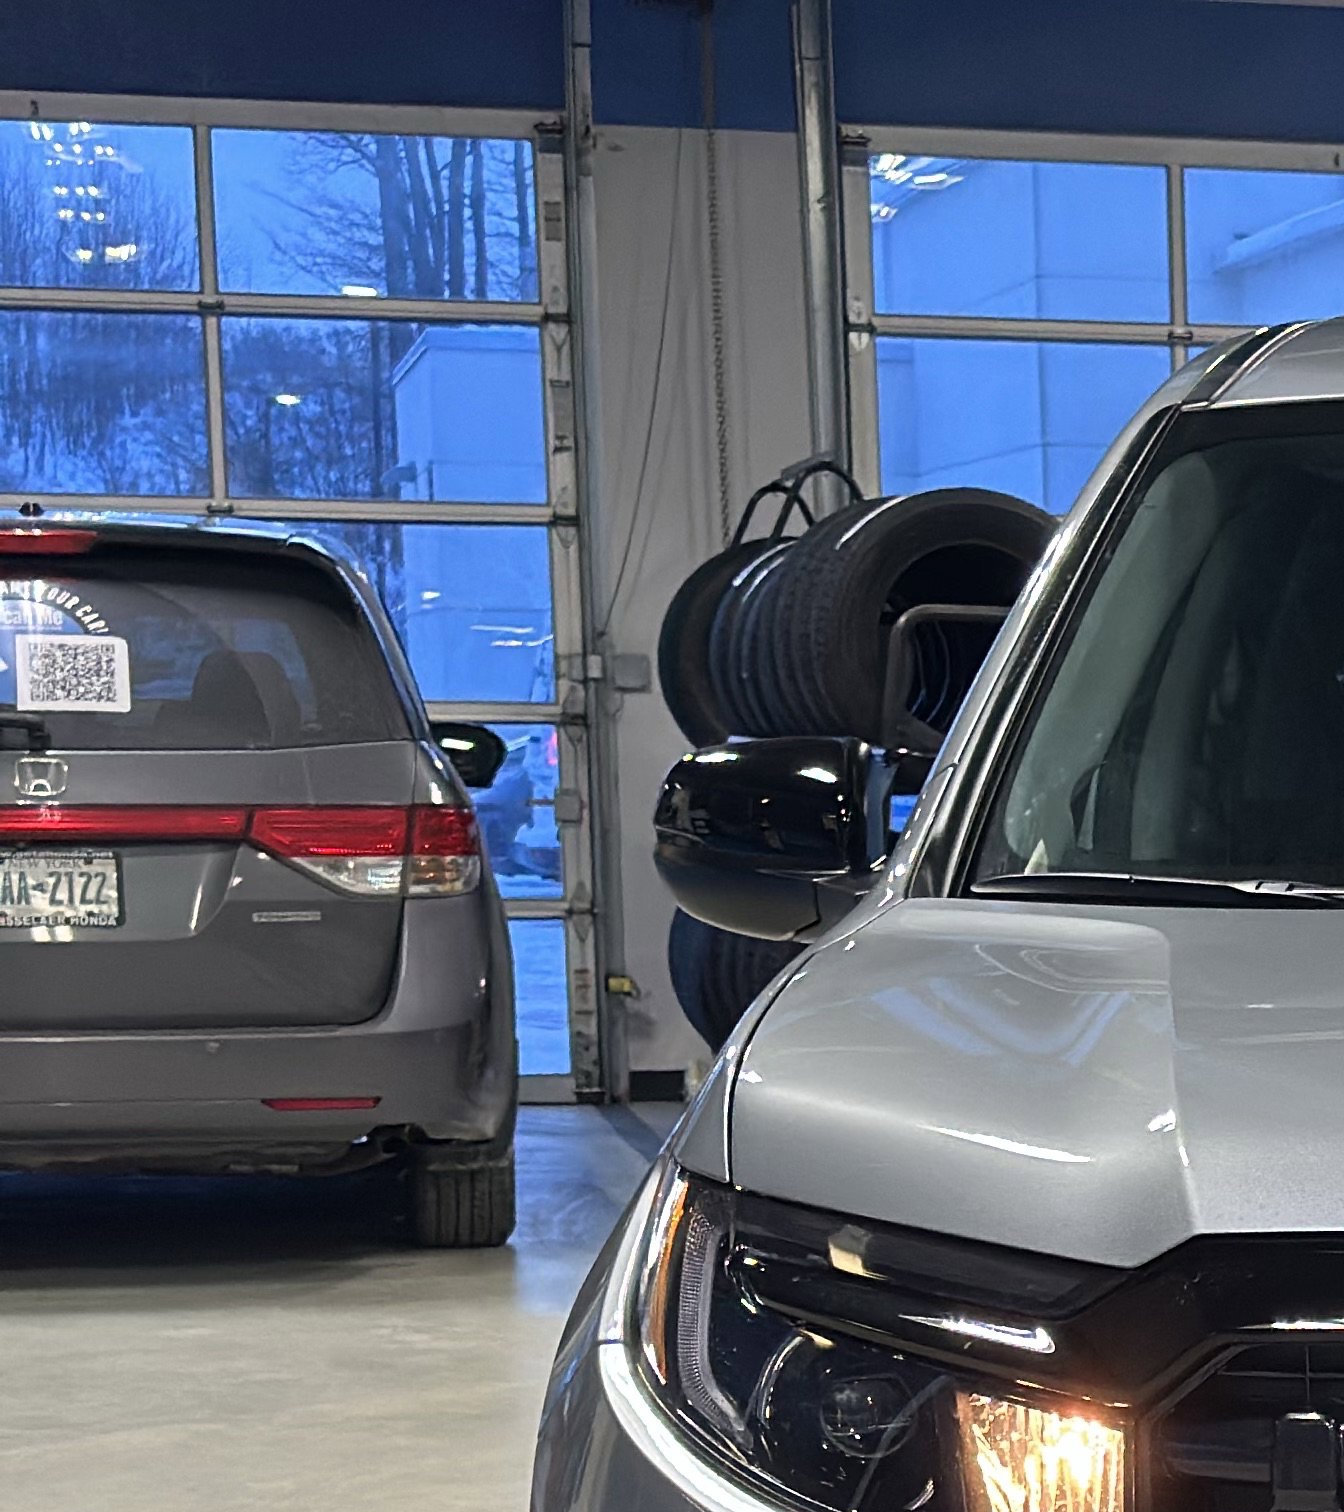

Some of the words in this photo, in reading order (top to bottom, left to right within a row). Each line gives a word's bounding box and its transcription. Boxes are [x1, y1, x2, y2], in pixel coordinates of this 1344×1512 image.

[33, 580, 80, 609] YOUR
[76, 605, 109, 634] CAR!
[70, 915, 117, 926] HONDA
